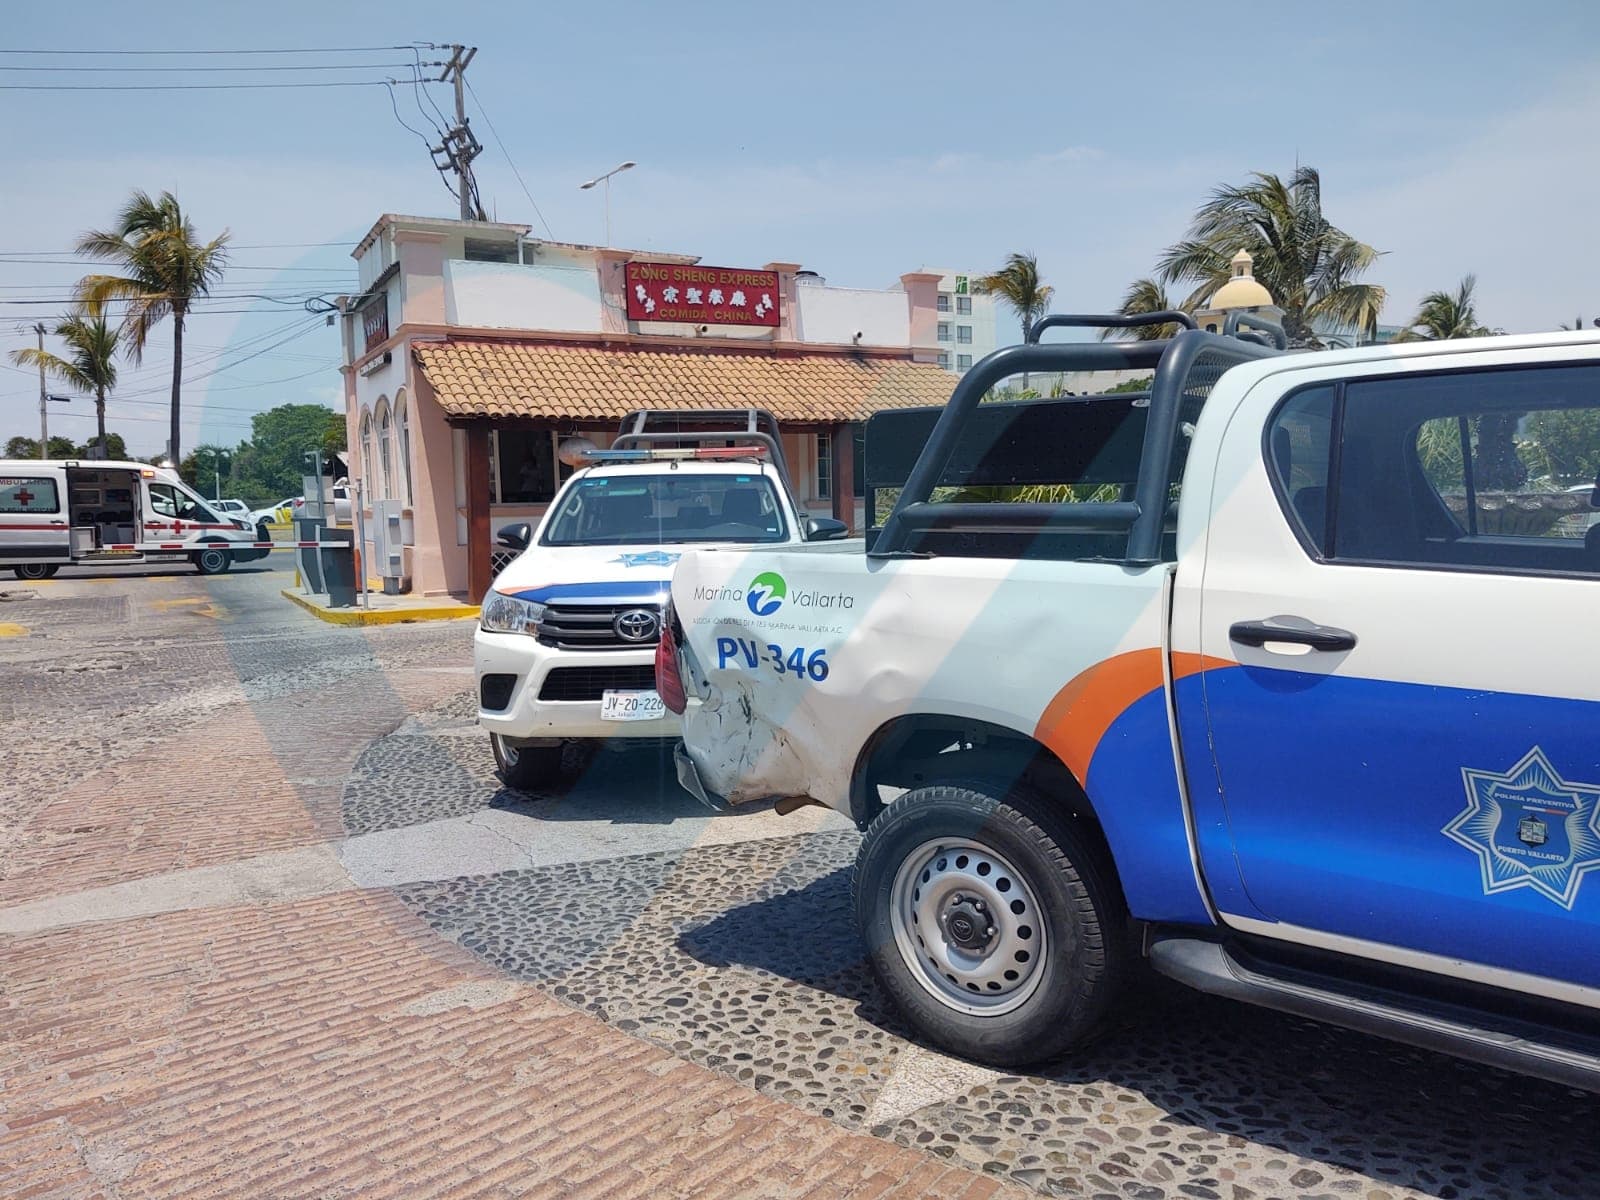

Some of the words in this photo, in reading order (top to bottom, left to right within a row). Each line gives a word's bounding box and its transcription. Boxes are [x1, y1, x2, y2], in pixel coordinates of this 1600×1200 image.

[631, 267, 669, 280] ZONG
[673, 269, 716, 284] SHENG
[720, 272, 775, 287] EXPRESS
[659, 308, 708, 319] COMIDA
[714, 310, 752, 321] CHINA
[693, 585, 743, 602] Marina
[791, 590, 854, 609] Vallarta
[716, 637, 829, 682] PV-346
[1526, 797, 1576, 809] PREVENTIVA
[1497, 845, 1527, 855] PUERTO
[1527, 850, 1565, 862] VALLARTA
